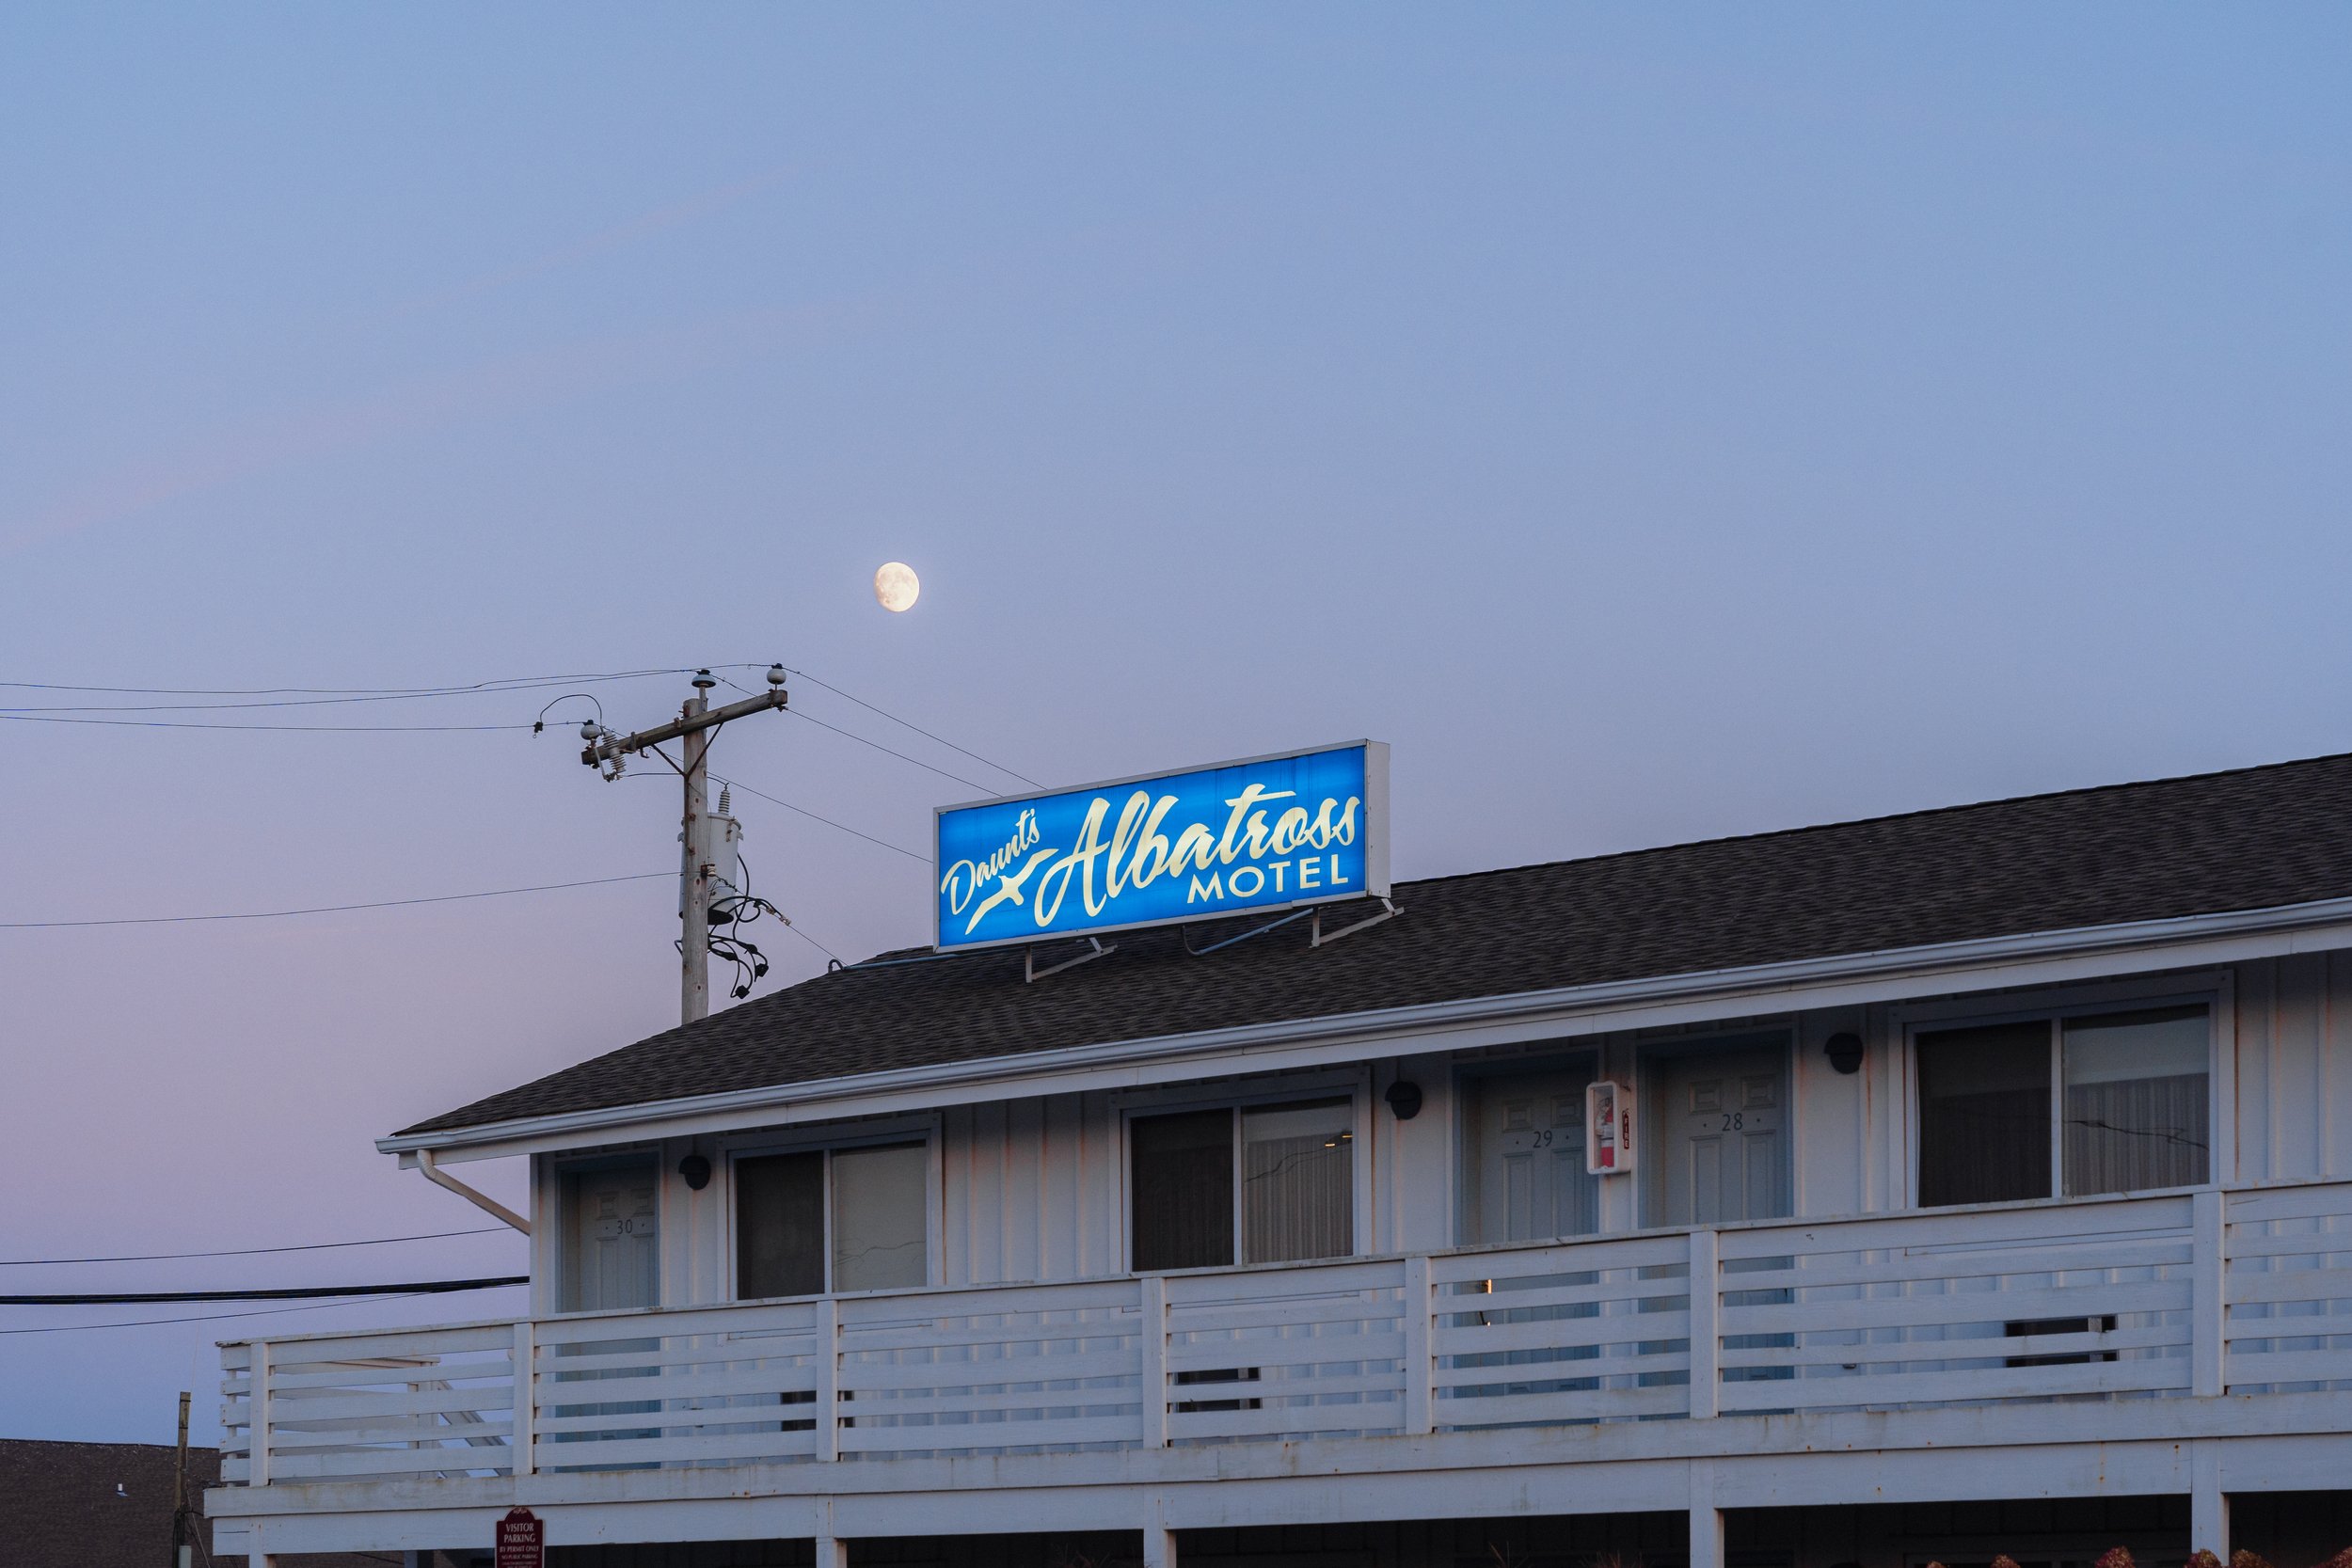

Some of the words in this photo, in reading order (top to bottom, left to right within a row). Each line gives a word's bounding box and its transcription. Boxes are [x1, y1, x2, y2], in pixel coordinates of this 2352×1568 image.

[941, 808, 1041, 915] Daunt's
[1034, 784, 1360, 927] Albatross
[1186, 854, 1348, 904] MOTEL
[1722, 1113, 1743, 1132] 28
[1533, 1130, 1552, 1148] 29
[616, 1219, 633, 1235] 30
[505, 1523, 534, 1532] VISITOR
[503, 1533, 535, 1543] PARKING
